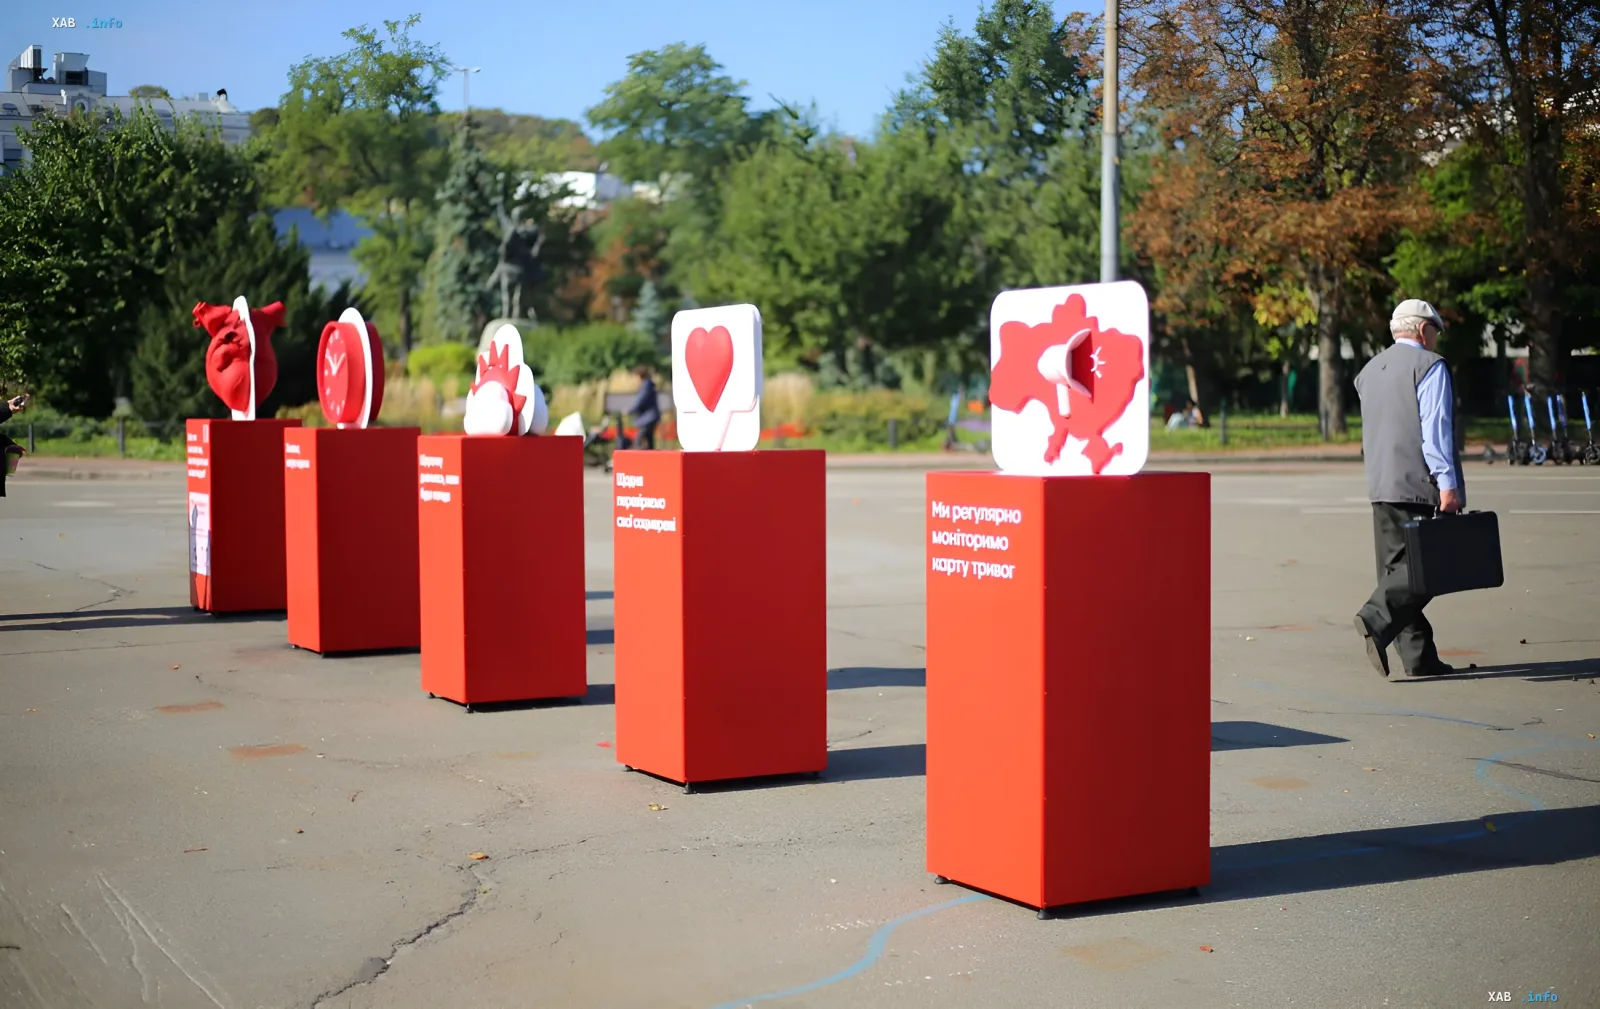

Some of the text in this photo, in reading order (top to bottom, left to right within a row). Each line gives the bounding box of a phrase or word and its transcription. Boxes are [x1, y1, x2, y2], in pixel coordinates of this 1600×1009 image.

[932, 500, 1021, 526] Ми регулярно
[932, 528, 1009, 551] моніторимо
[932, 557, 1016, 580] карту тривог
